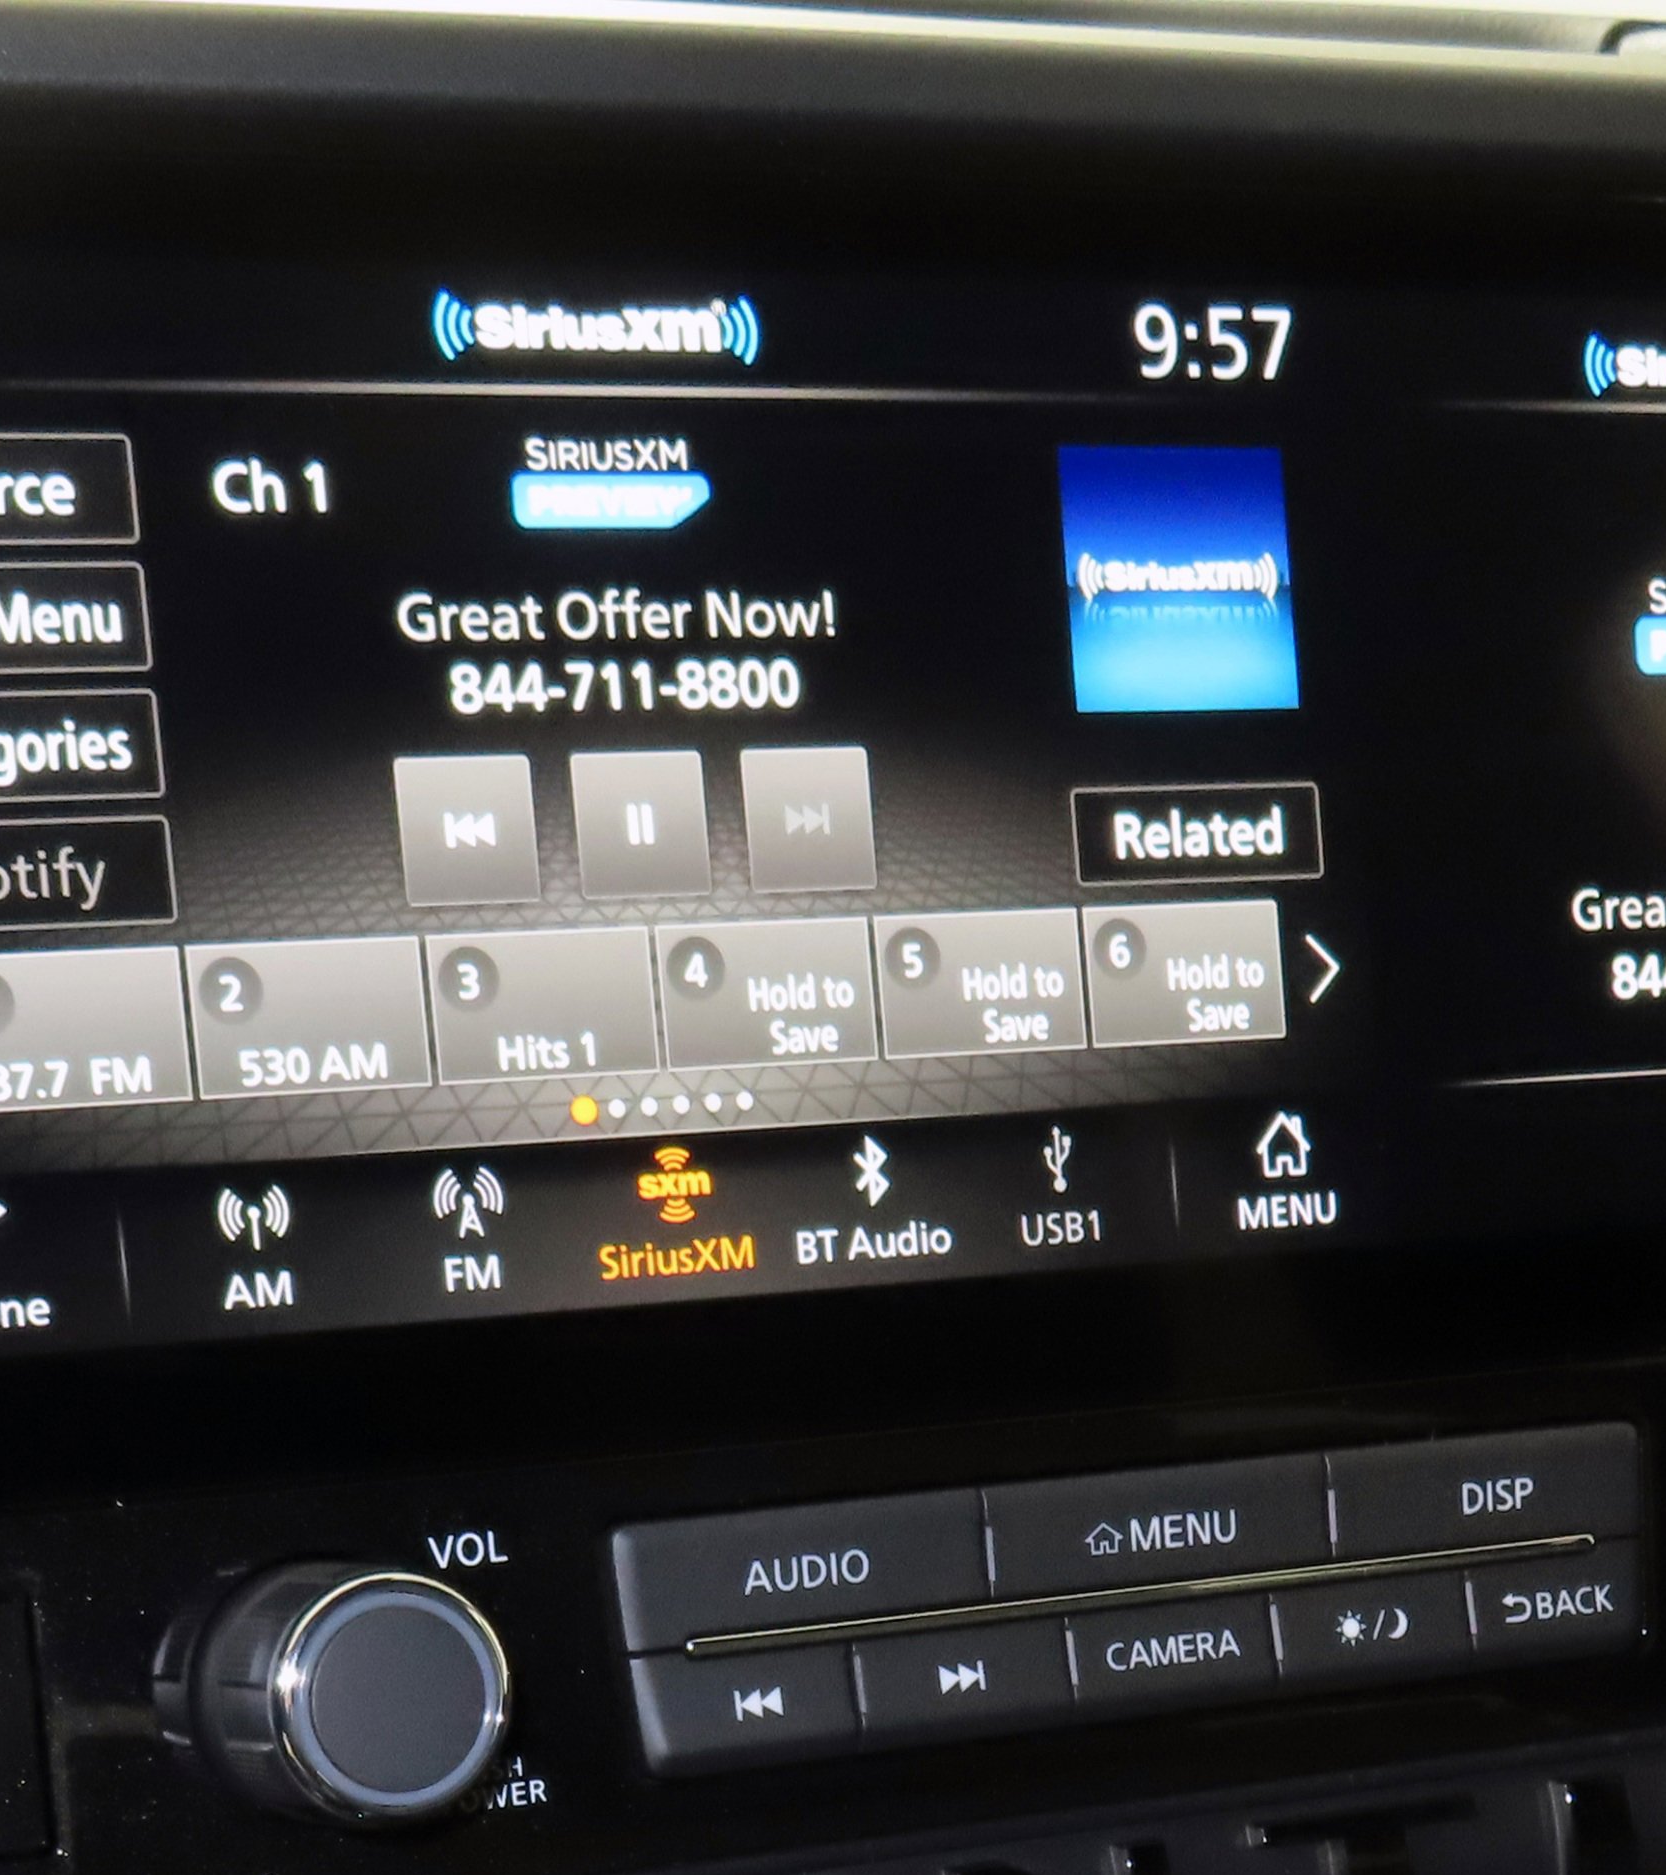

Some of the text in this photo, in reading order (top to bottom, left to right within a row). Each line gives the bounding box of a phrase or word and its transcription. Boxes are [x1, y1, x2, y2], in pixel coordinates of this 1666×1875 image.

[1133, 304, 1291, 380] 9:57
[212, 458, 328, 514] Ch 1
[397, 588, 836, 642] Great Offer Now!
[449, 658, 800, 715] 844-711-8800
[1113, 805, 1284, 860] Related
[684, 952, 709, 988] 4
[902, 943, 924, 979] 5
[1108, 933, 1131, 969] 6
[457, 963, 481, 1001] 3
[747, 971, 855, 1012] Hold to
[961, 961, 1065, 1001] Hold to
[1166, 953, 1265, 991] Hold to
[218, 974, 244, 1013] 2
[982, 1007, 1049, 1044] Save
[1186, 997, 1250, 1033] Save
[497, 1031, 597, 1077] Hits 1
[769, 1018, 839, 1055] Save
[89, 1055, 153, 1095] FM
[238, 1042, 388, 1087] 530 AM
[637, 1163, 712, 1201] sxm
[1021, 1209, 1101, 1247] USB1
[1237, 1191, 1337, 1230] MENU
[598, 1235, 755, 1281] SiriusXM
[795, 1220, 952, 1265] BT Audio
[224, 1270, 294, 1310] AM
[444, 1254, 501, 1293] FM
[1461, 1477, 1534, 1515] DISP
[427, 1530, 509, 1569] VOL
[1130, 1509, 1236, 1552] MENU
[744, 1549, 869, 1596] AUDIO
[1535, 1584, 1614, 1620] BACK
[1106, 1629, 1241, 1671] CAMERA
